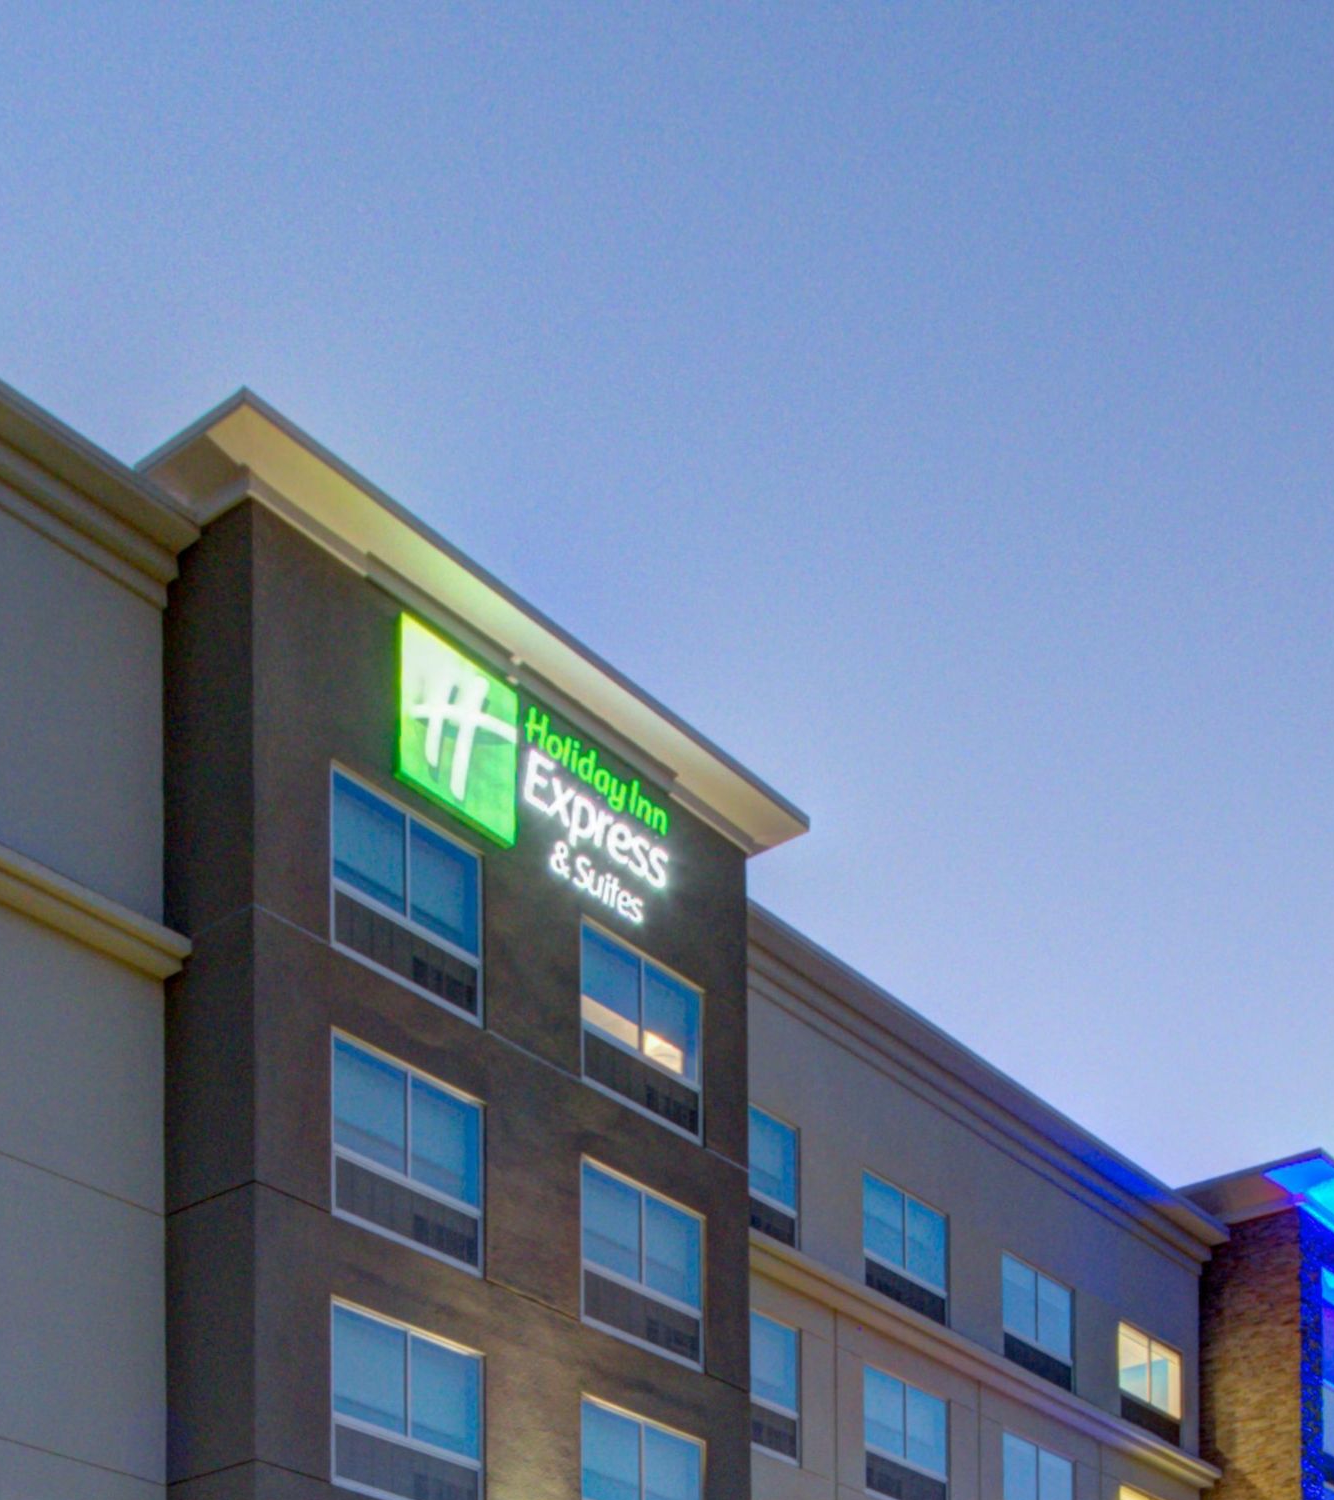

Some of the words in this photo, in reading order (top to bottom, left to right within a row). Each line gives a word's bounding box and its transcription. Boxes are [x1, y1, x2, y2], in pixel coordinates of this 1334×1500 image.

[524, 749, 669, 889] Express
[525, 706, 627, 813] Holiday
[630, 780, 668, 836] Inn
[549, 841, 571, 879] &
[572, 855, 644, 924] Suites
